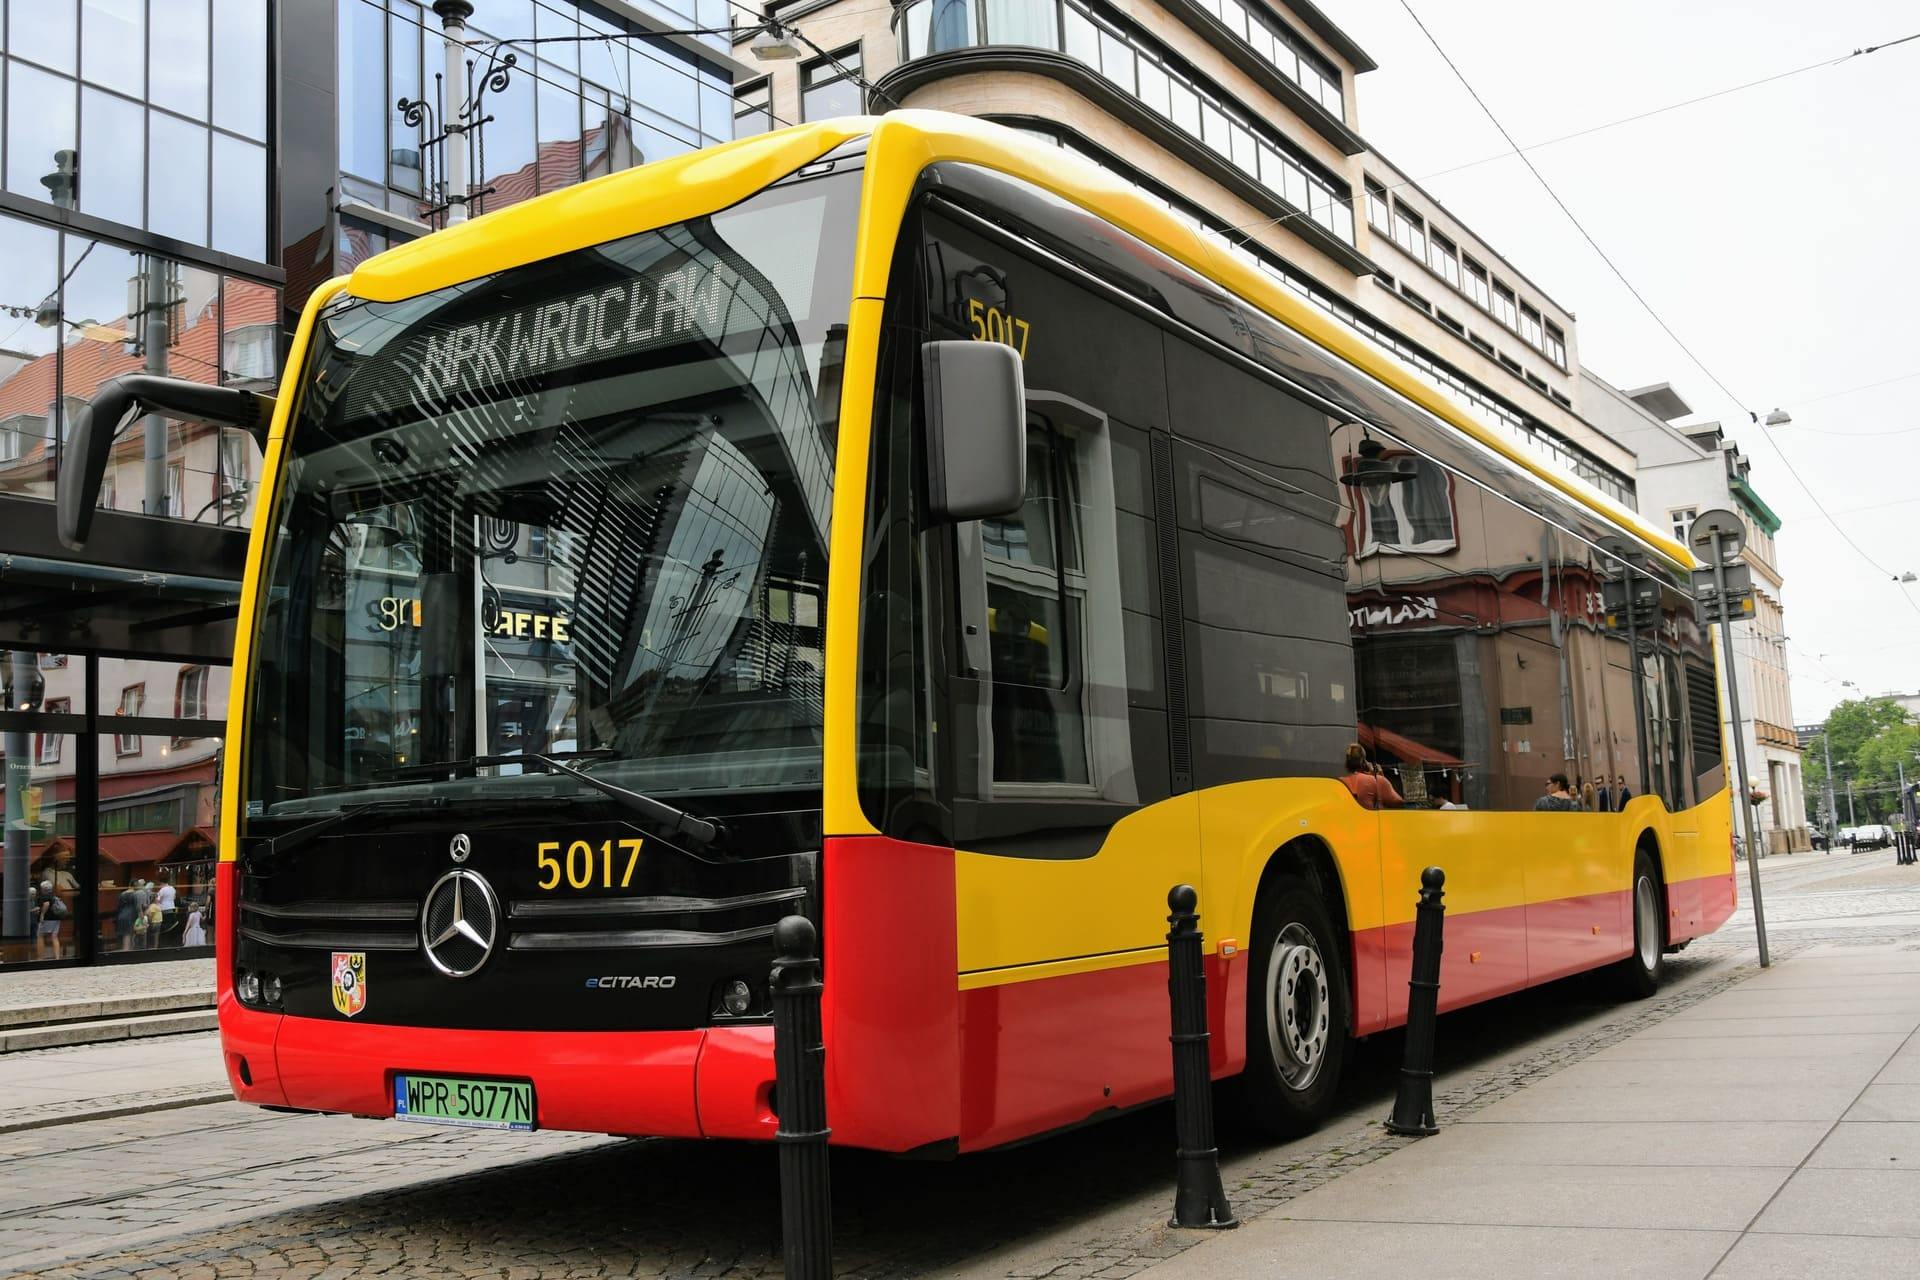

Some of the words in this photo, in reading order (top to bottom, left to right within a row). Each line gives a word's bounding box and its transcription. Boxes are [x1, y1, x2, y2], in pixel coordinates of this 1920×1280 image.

[970, 298, 1029, 361] 5017
[538, 839, 644, 890] 5017
[585, 975, 676, 989] eCITARO
[407, 1080, 449, 1115] WPR
[457, 1083, 531, 1121] 5077N
